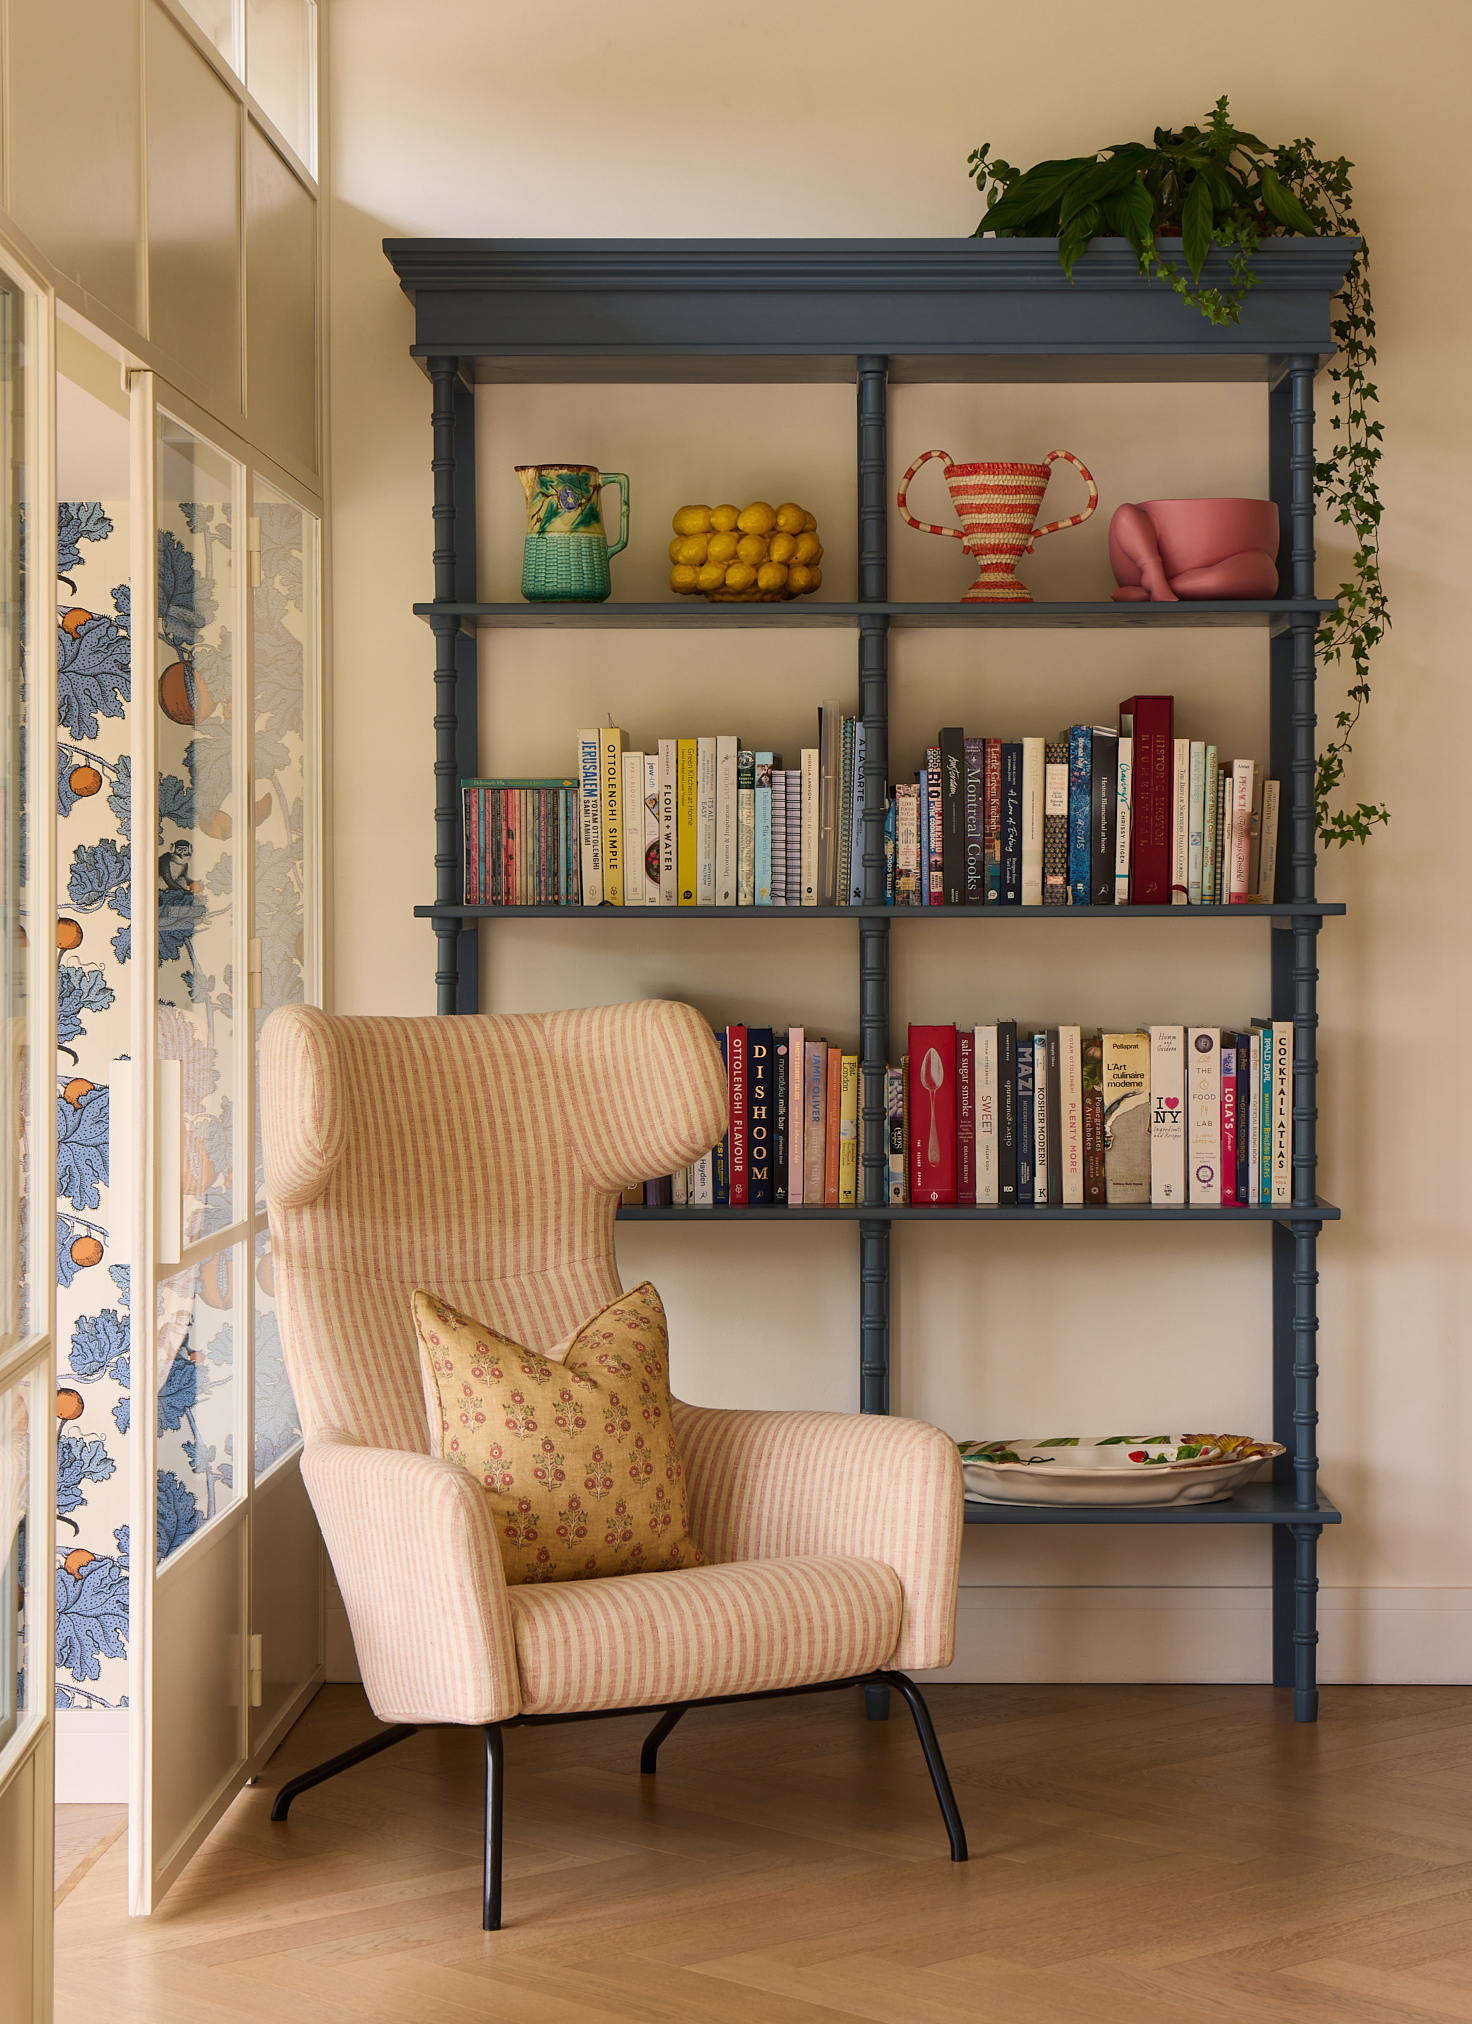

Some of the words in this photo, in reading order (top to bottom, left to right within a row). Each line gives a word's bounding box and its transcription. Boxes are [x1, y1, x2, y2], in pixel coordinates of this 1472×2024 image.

[582, 741, 598, 797] JERUSALEM
[859, 750, 865, 761] LA
[991, 748, 999, 769] Little
[1030, 748, 1039, 785] create
[1077, 757, 1087, 768] hay
[1156, 735, 1164, 791] HISTORIC
[607, 745, 616, 821] OTTOLENGHI
[857, 766, 865, 802] CARTE
[928, 772, 940, 798] RIO
[947, 755, 960, 797] Amsterdam
[991, 772, 999, 796] Green
[1117, 763, 1130, 810] Cravings
[1238, 776, 1247, 811] PESACH
[967, 767, 980, 837] Montreal
[1005, 827, 1017, 852] Eating
[1155, 798, 1164, 845] HESTON
[609, 828, 618, 870] SIMPLE
[664, 833, 672, 871] WATER
[967, 844, 981, 890] Cooks
[962, 1039, 971, 1056] salt
[733, 1039, 742, 1114] OTTOLENGHI
[813, 1054, 821, 1083] JAMIE
[959, 1058, 970, 1084] sugar
[1018, 1047, 1032, 1095] MAZI
[1263, 1064, 1271, 1083] DAHL
[1278, 1038, 1287, 1116] COCKTAIL
[751, 1045, 769, 1179] DISHOOM
[812, 1087, 820, 1122] OLIVER
[962, 1085, 971, 1116] smoke
[982, 1095, 992, 1135] SWEET
[1005, 1080, 1013, 1121] gourmando
[1154, 1111, 1181, 1123] NY
[1157, 1097, 1163, 1109] I
[1225, 1088, 1234, 1129] LOLA'S
[891, 1127, 902, 1149] eggs
[1004, 1127, 1012, 1146] olive
[1094, 1096, 1102, 1151] Pomegranates
[734, 1120, 742, 1172] FLAVOUR
[810, 1127, 820, 1160] jamie's
[1278, 1123, 1286, 1168] ATLAS
[810, 1165, 820, 1186] italy
[1039, 1189, 1046, 1197] K
